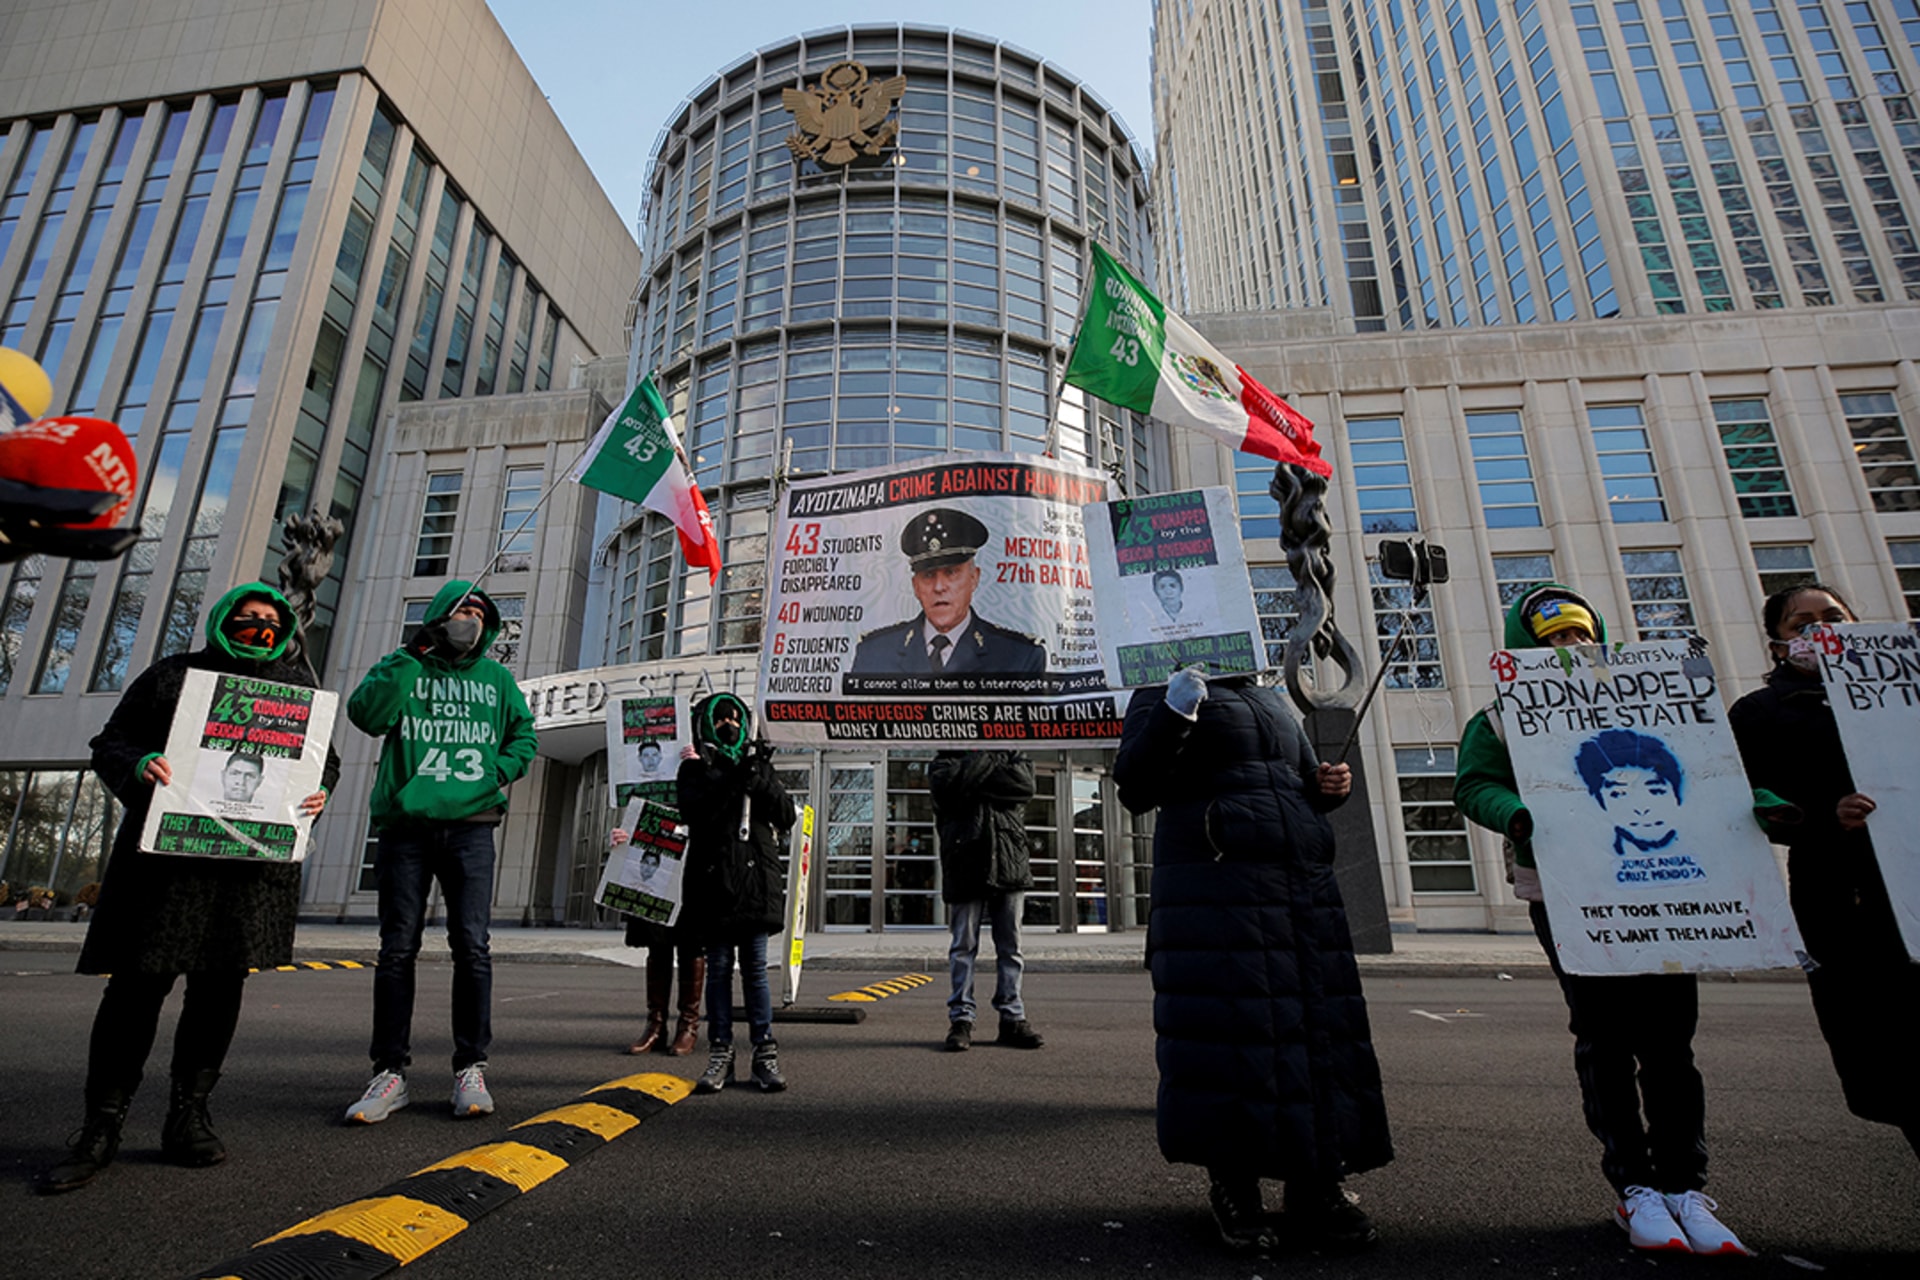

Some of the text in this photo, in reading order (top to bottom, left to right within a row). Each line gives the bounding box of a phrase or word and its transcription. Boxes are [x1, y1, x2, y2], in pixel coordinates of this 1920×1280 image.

[1110, 335, 1139, 367] 43
[623, 433, 658, 462] 43
[793, 468, 1103, 514] AYOTZINAPA CRIME AGAINST HUMANITY
[1117, 492, 1202, 514] STUDENTS
[785, 523, 883, 556] 43 STUDENTS
[1118, 516, 1154, 546] 43
[1161, 526, 1202, 539] by the
[1005, 537, 1072, 564] MEXICAN
[782, 557, 839, 575] FORCIBLY
[996, 562, 1035, 584] 27th
[1125, 563, 1147, 575] SEP
[780, 575, 862, 593] DISAPPEARED
[777, 602, 863, 624] 40 WOUNDED
[773, 633, 850, 655] 6 STUDENTS
[1119, 647, 1146, 663] THEY
[770, 656, 841, 674] & CIVILIANS
[1050, 653, 1099, 668] Organized
[225, 677, 313, 701] STUDENTS
[410, 677, 497, 707] UNNING
[767, 676, 833, 694] MURDERED
[863, 680, 898, 689] cannot
[901, 679, 931, 689] allow
[934, 679, 959, 689] them
[963, 680, 976, 689] to
[981, 679, 1049, 691] interrogate
[1052, 681, 1065, 691] my
[1495, 671, 1716, 711] KIDNAPPED
[1845, 683, 1885, 710] BY
[213, 692, 309, 724] 43 KIDNAPPED
[432, 703, 471, 717] FOR
[770, 703, 832, 721] GENERAL
[932, 704, 989, 722] CRIMES
[994, 705, 1024, 721] ARE
[1028, 704, 1060, 721] NOT
[1064, 701, 1112, 721] ONLY:
[1517, 700, 1715, 736] BY THE STATE
[258, 715, 299, 727] by the
[830, 722, 878, 739] MONEY
[883, 723, 978, 739] LAUNDERING
[982, 723, 1027, 739] DRUG
[204, 721, 304, 748] MEXICAN GOVERNMENT
[208, 738, 232, 750] SEP
[262, 744, 290, 758] 2014
[417, 748, 485, 782] 43
[162, 814, 193, 831] THEY
[159, 835, 178, 851] WE
[182, 837, 216, 854] WANT
[220, 841, 250, 855] THEM
[1616, 870, 1649, 883] CRUZ
[1580, 904, 1614, 919] THEY
[1618, 903, 1661, 918] TOOK
[1663, 902, 1701, 916] THEM
[1586, 919, 1757, 945] WE WANT THEM ALIVE!
